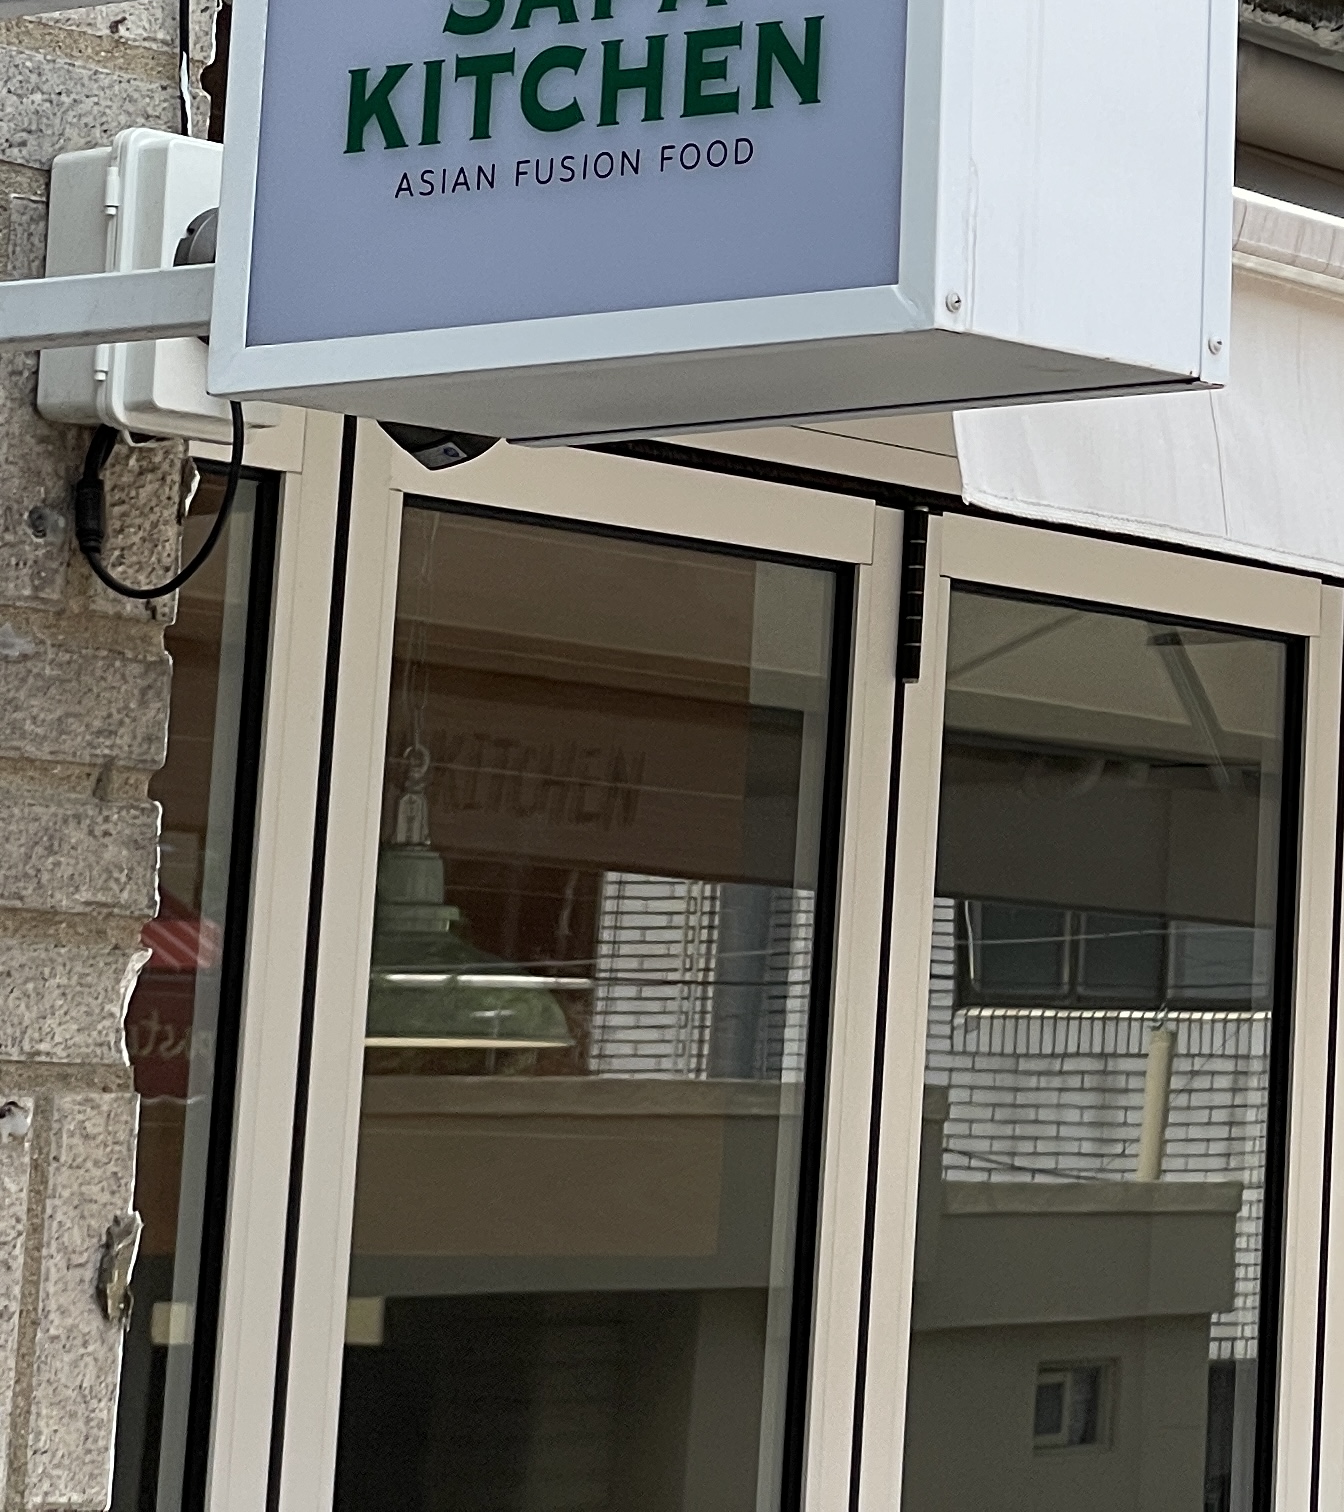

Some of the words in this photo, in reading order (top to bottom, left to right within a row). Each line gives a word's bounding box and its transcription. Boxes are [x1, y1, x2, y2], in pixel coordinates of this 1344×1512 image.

[342, 15, 825, 155] KITCHEN
[394, 163, 497, 199] ASIAN
[514, 148, 642, 188] FUSION
[659, 136, 756, 173] FOOD
